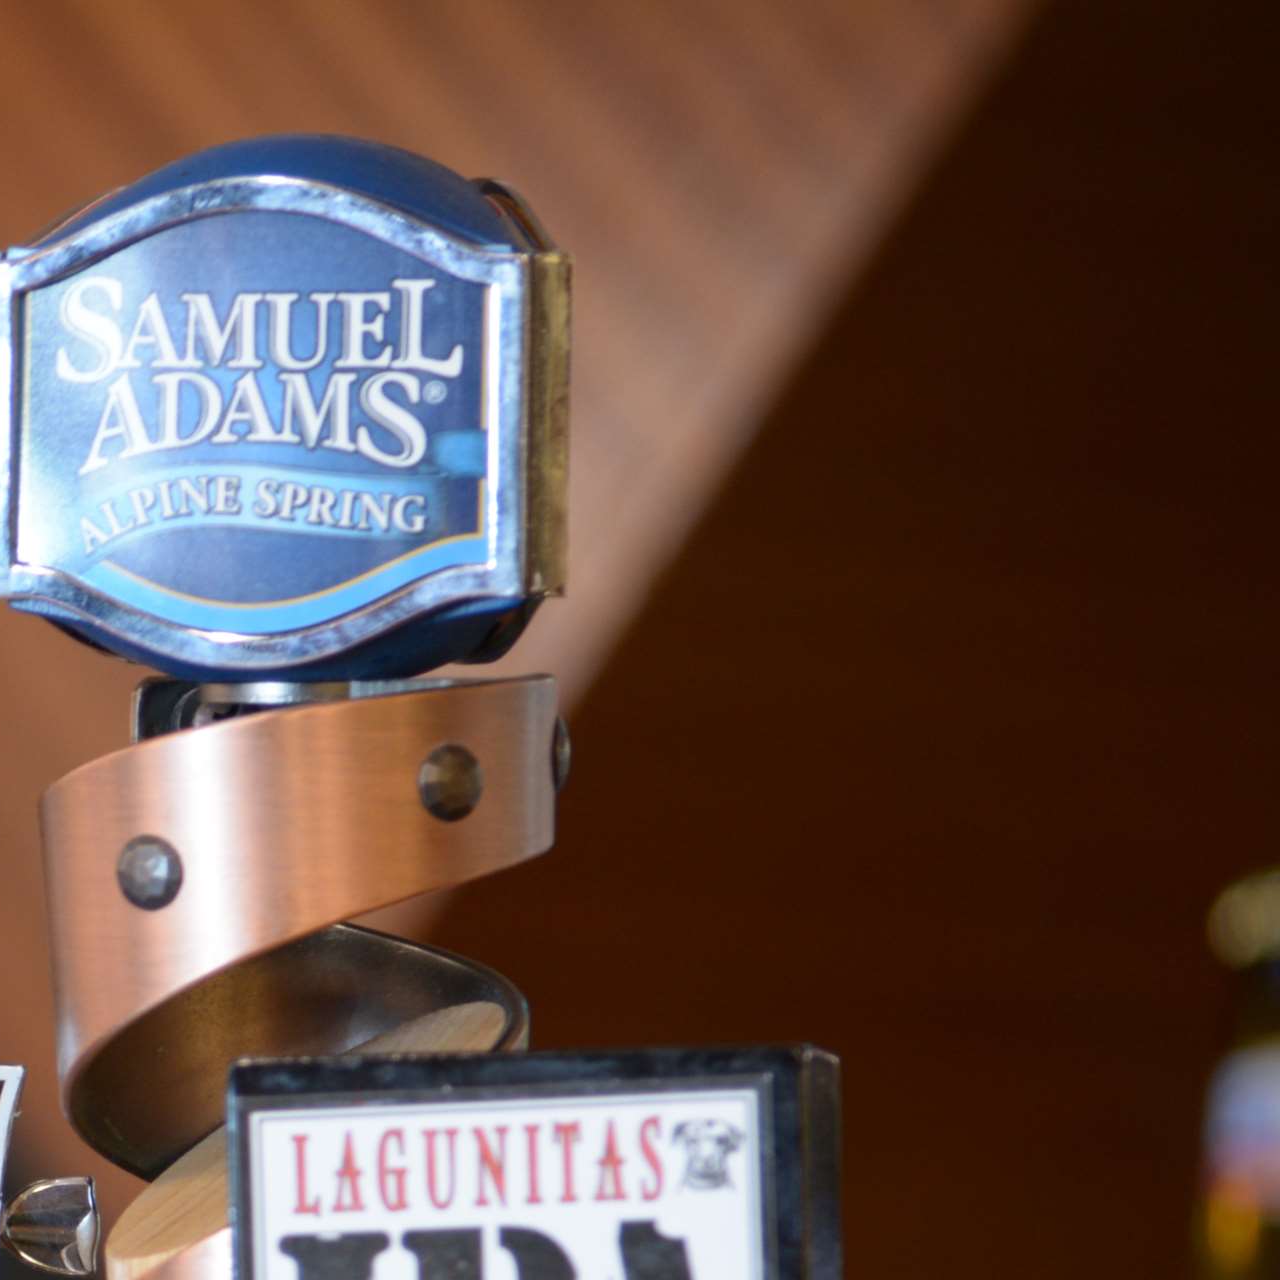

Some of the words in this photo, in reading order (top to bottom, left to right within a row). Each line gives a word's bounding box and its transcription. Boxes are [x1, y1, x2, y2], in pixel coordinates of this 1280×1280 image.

[54, 276, 465, 385] SAMUEL
[78, 476, 242, 554] ALPINE
[254, 478, 428, 534] SPRING
[290, 1116, 665, 1217] LAGUNITAS
